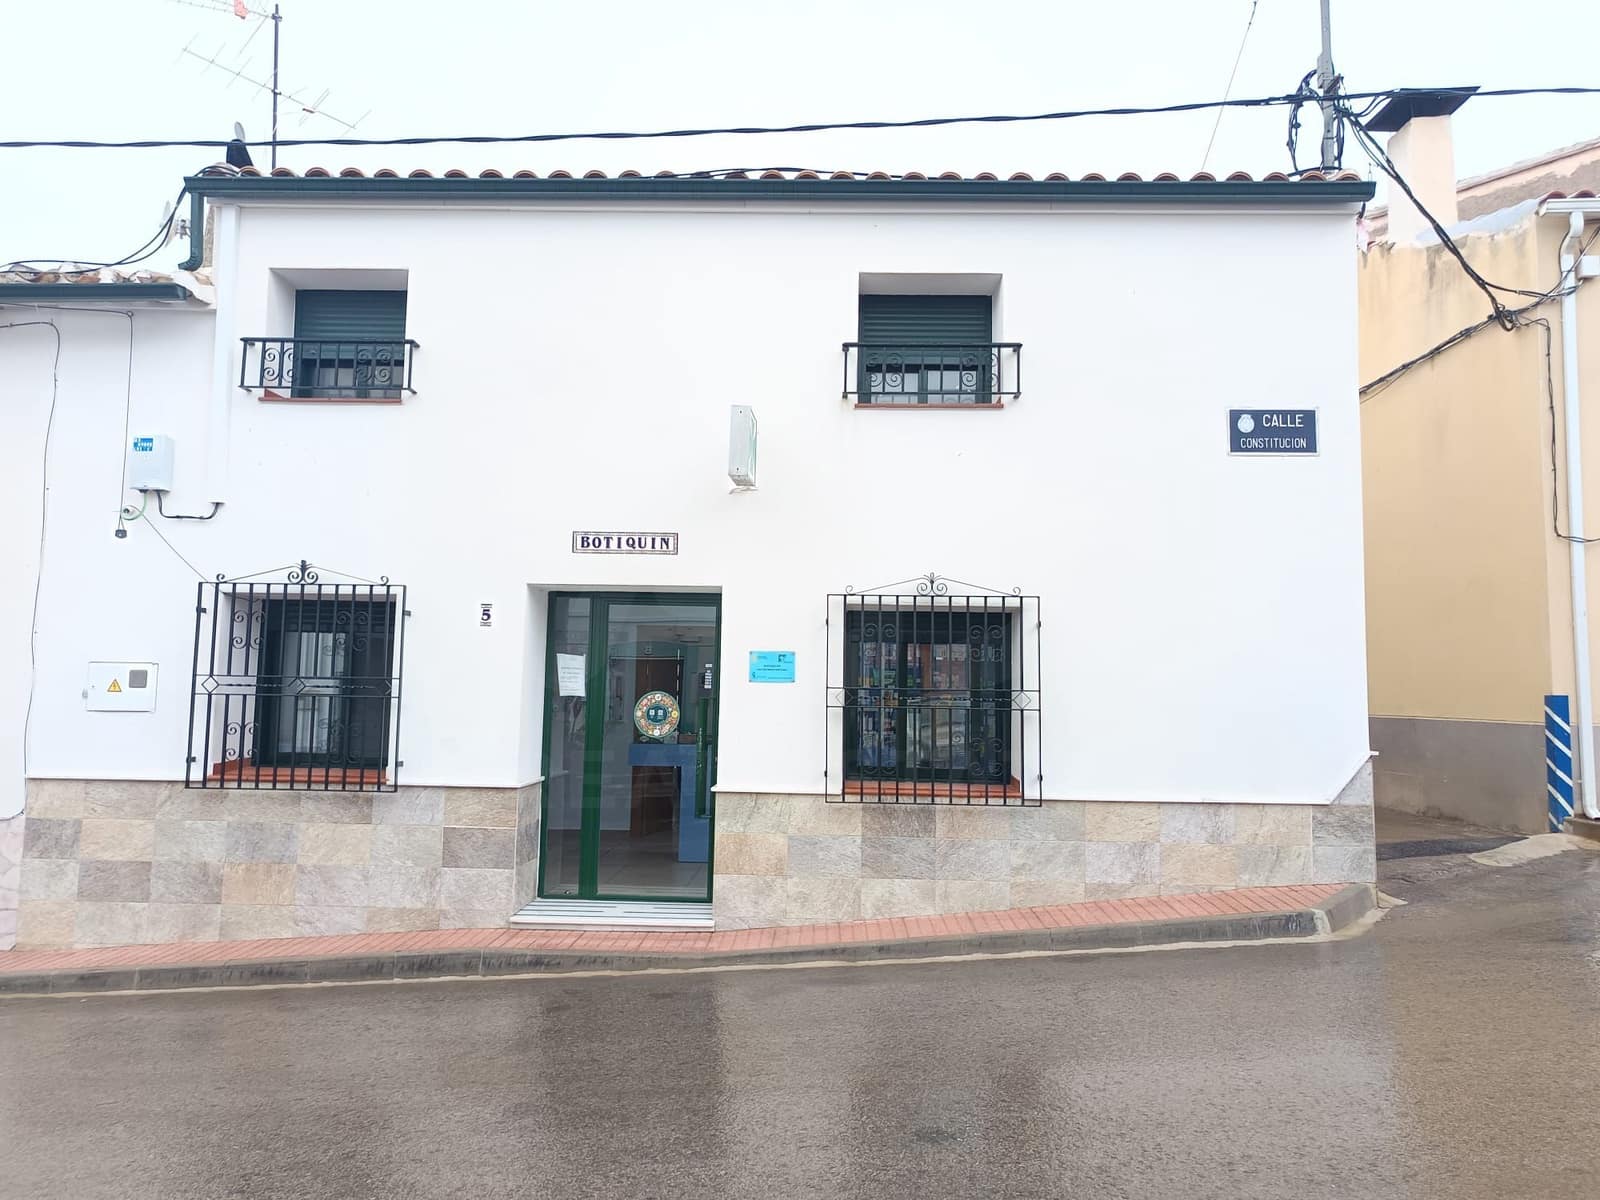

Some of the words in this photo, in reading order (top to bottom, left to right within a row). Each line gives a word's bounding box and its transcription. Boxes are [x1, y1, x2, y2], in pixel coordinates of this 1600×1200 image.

[1262, 414, 1304, 427] CALLE
[1240, 437, 1307, 449] CONSTITUCION
[580, 535, 670, 549] BOTIQUIN
[481, 608, 491, 621] 5
